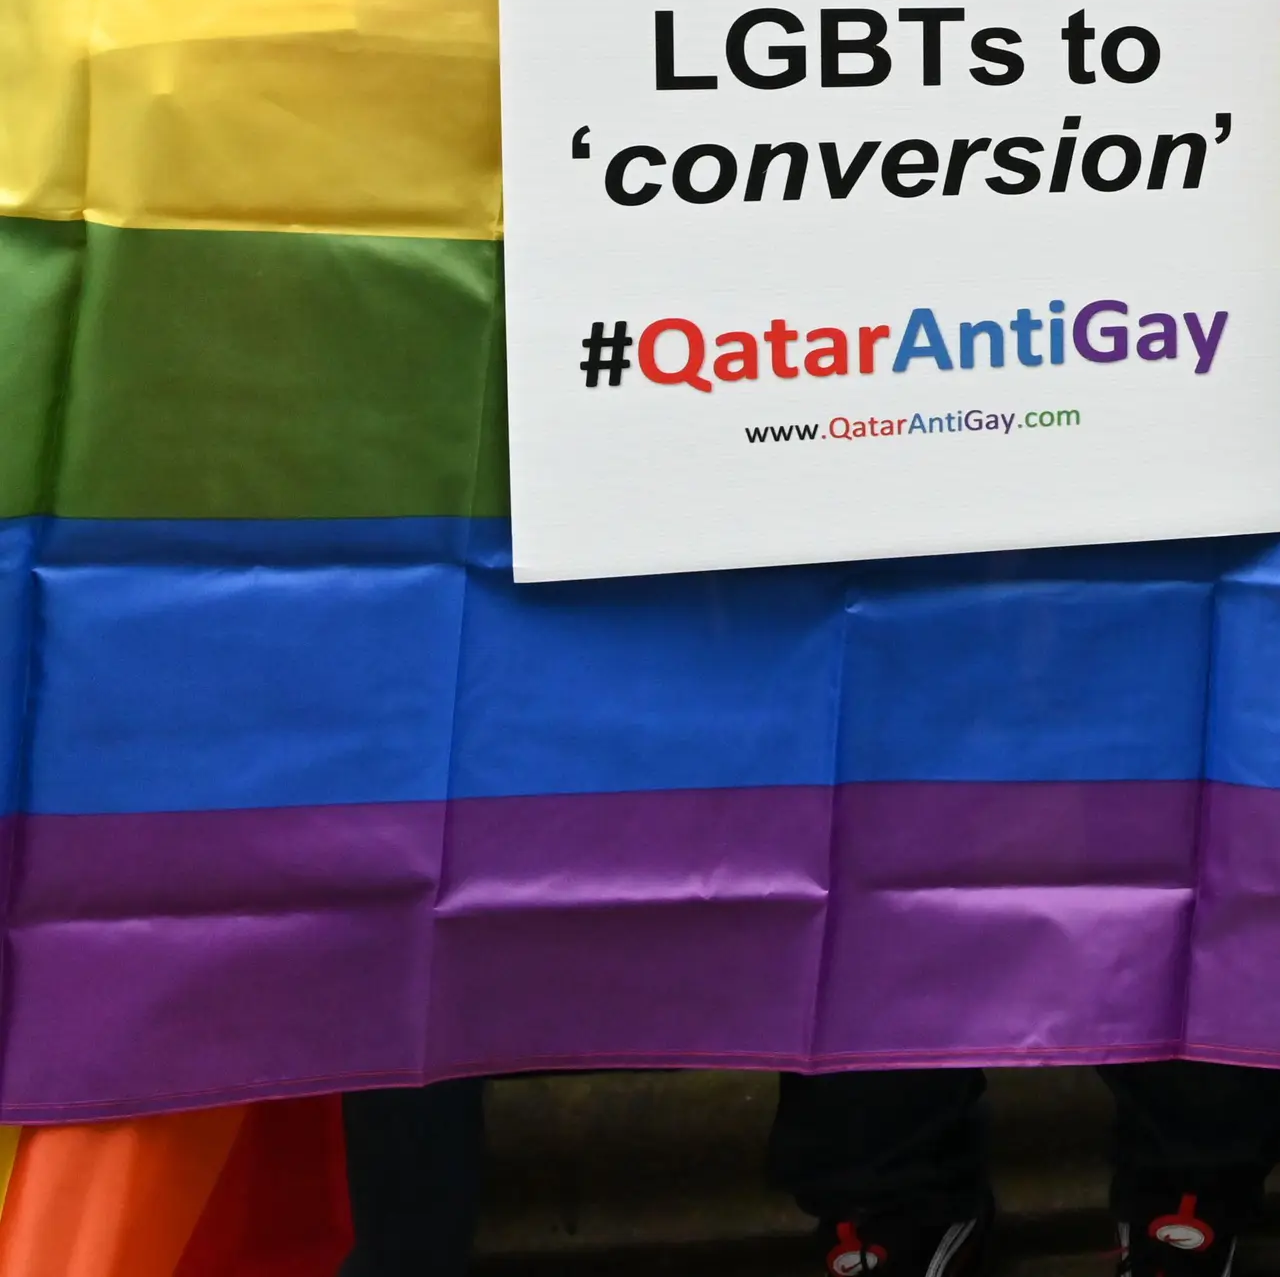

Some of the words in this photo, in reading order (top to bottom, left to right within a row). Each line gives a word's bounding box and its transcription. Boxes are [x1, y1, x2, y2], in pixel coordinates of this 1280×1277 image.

[654, 7, 1025, 91] LGBTs
[1060, 8, 1161, 85] to
[571, 112, 1232, 207] ‘conversion’
[579, 299, 1229, 394] #QatarAntiGay
[743, 405, 1082, 445] www.QatarAntiGay.com
